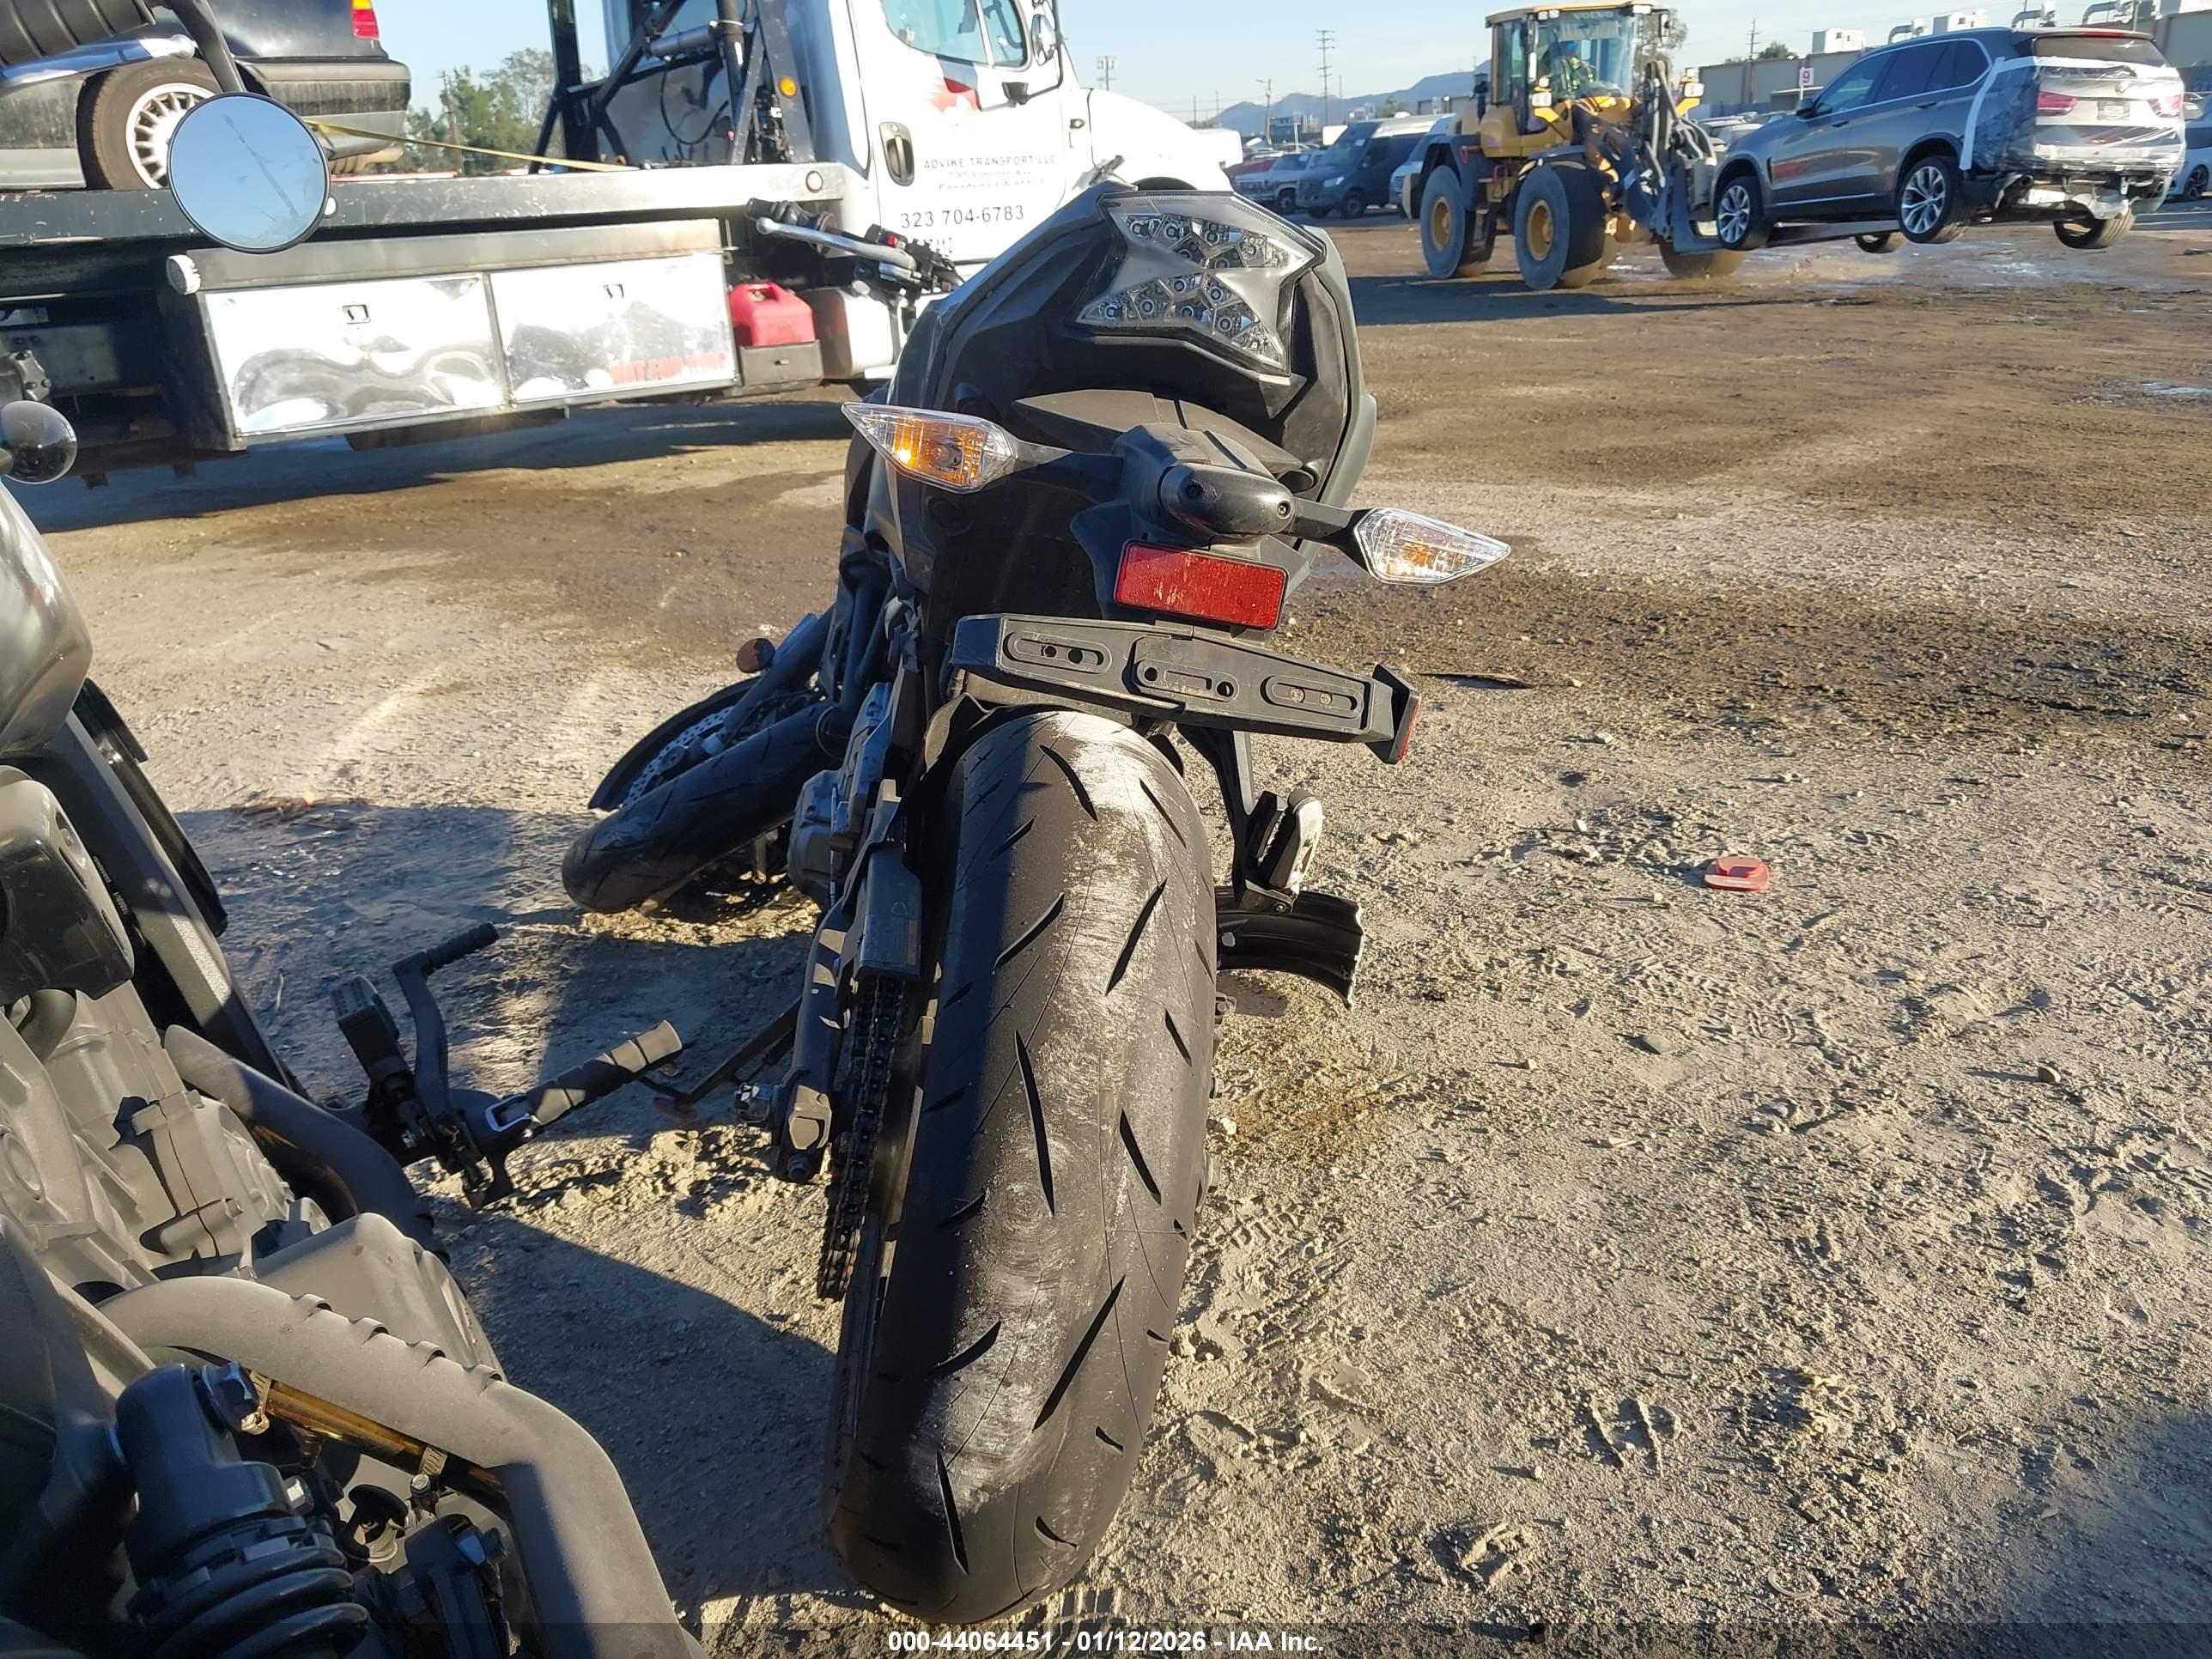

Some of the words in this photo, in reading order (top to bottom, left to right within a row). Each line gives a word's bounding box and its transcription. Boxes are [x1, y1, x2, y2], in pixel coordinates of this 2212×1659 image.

[1802, 70, 1810, 84] 9
[923, 157, 964, 169] ADVIKE
[969, 155, 1033, 167] TRANSPORT
[1037, 154, 1057, 165] LLC
[900, 210, 934, 229] 323
[941, 204, 1024, 226] 704-6783
